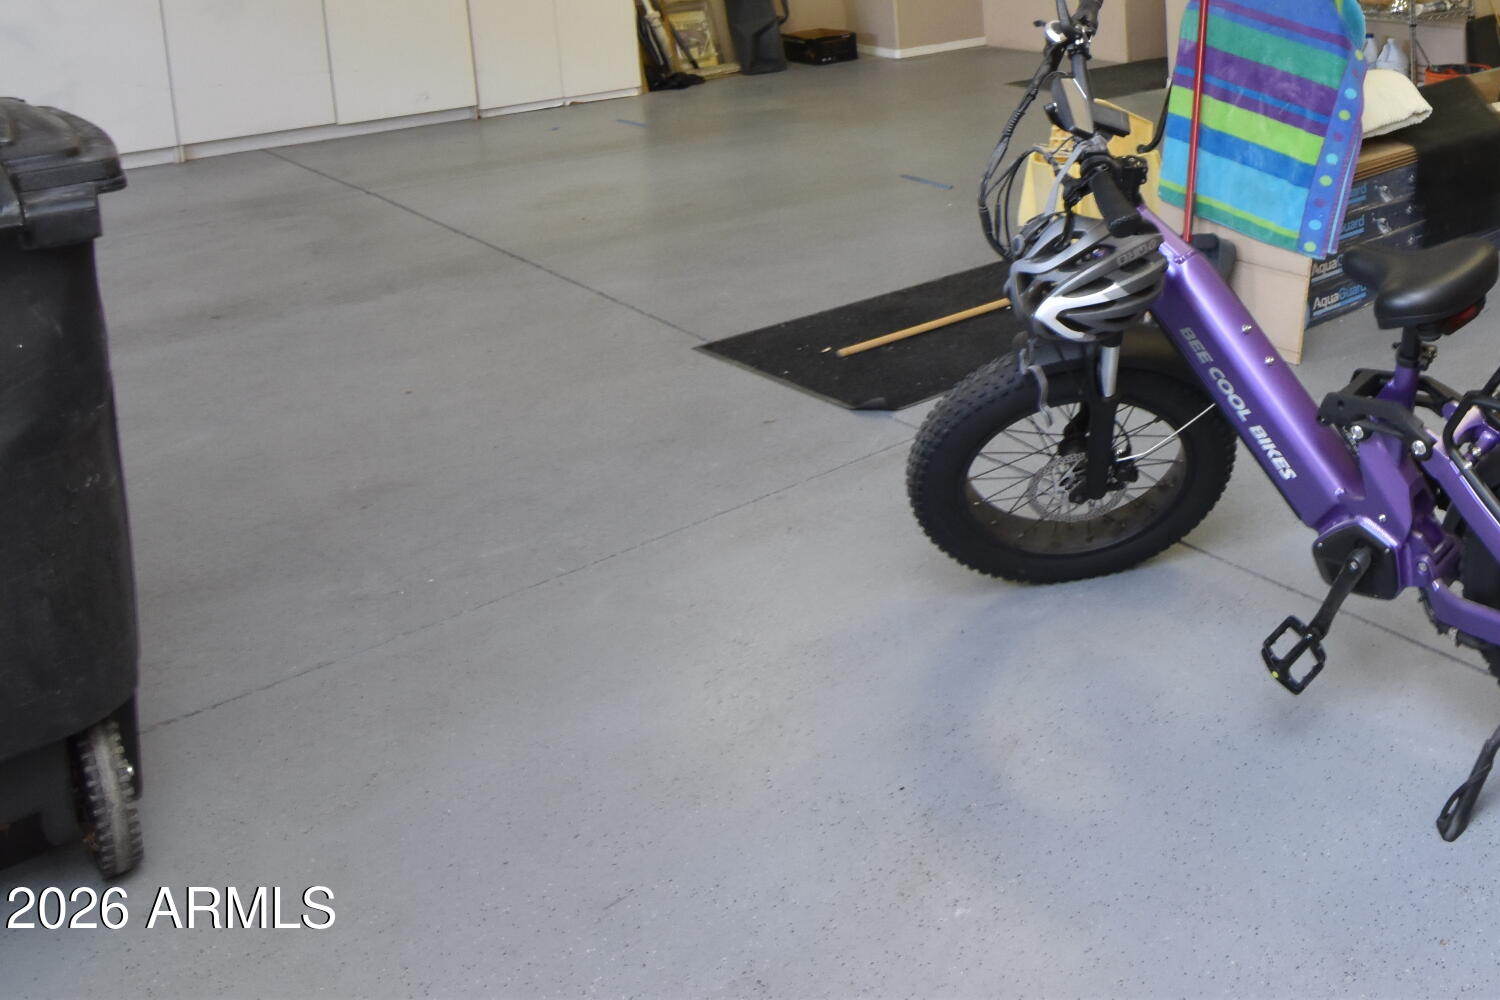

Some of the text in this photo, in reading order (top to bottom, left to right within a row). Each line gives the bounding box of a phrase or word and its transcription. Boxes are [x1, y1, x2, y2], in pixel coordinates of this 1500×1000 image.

[1312, 254, 1344, 275] AquaG
[1180, 327, 1297, 480] BEE COOL BIKES
